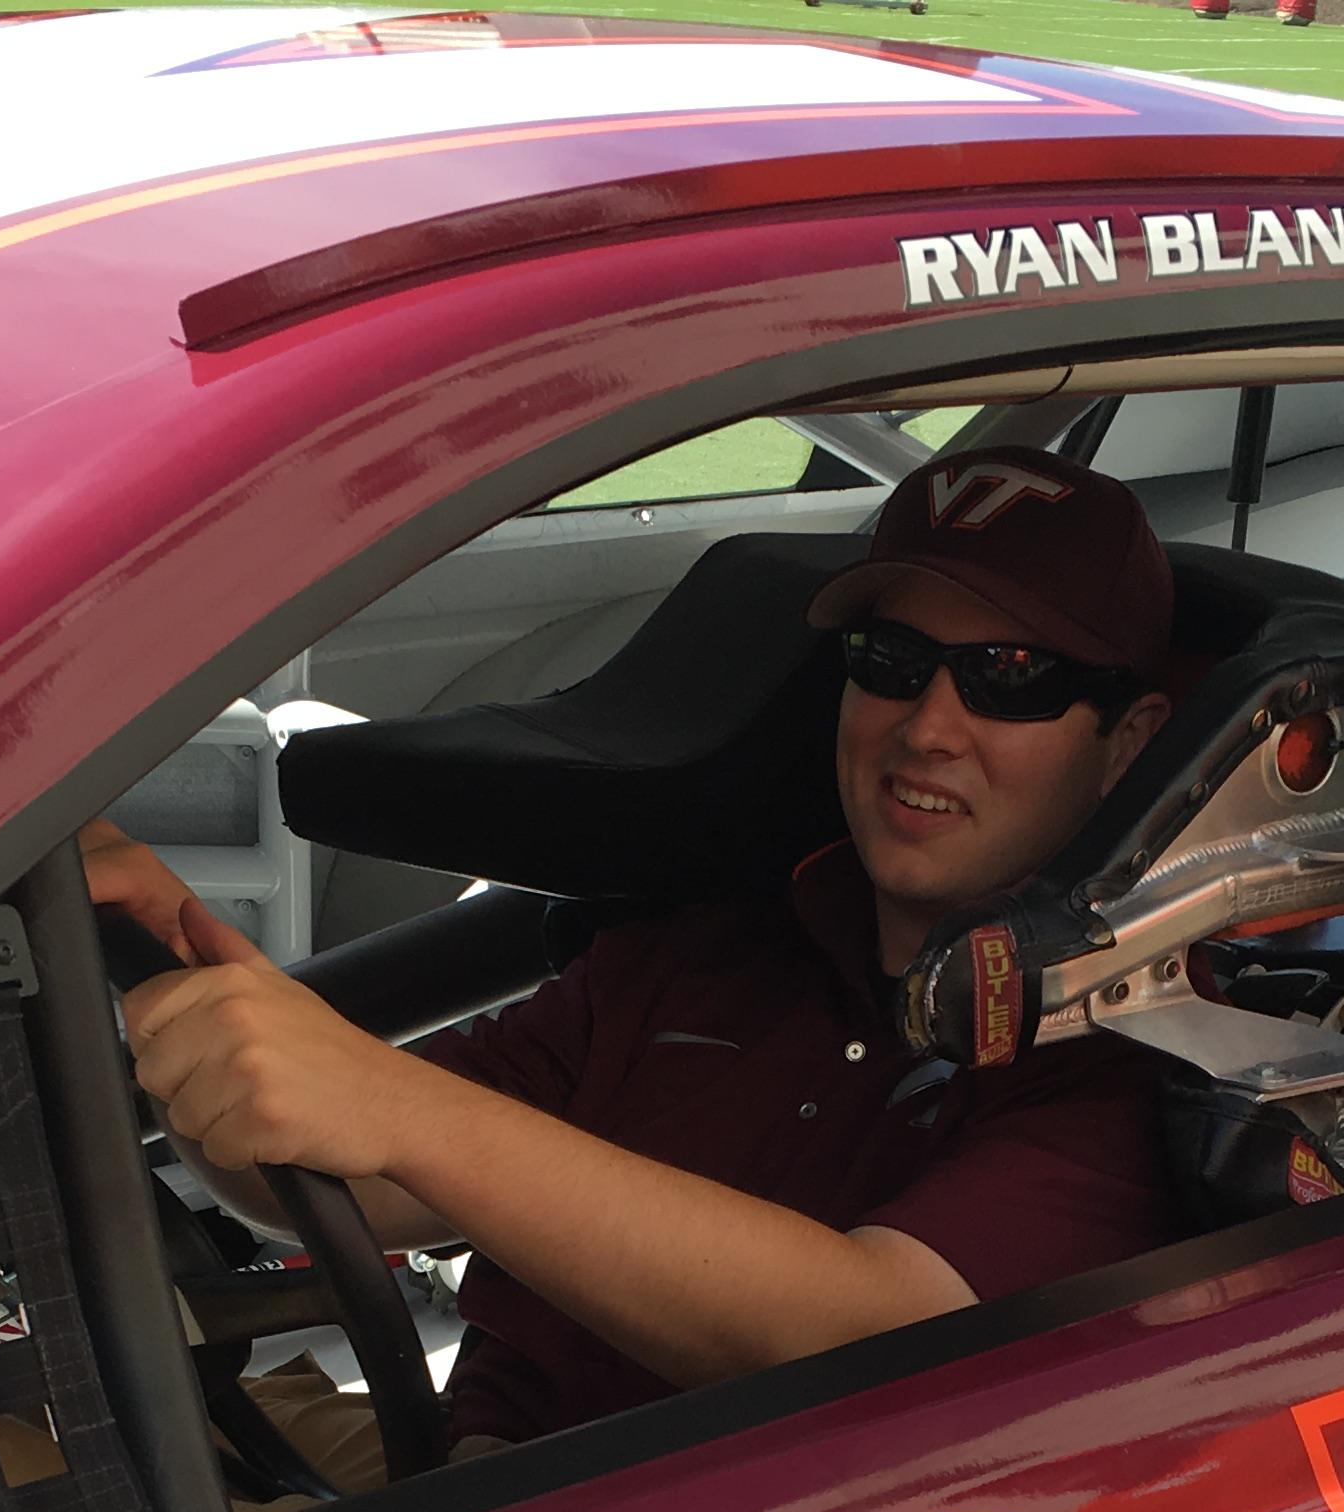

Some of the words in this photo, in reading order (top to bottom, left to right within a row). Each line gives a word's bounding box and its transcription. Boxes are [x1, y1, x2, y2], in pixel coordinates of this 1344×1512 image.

[901, 217, 1119, 306] RYAN
[928, 463, 1076, 531] VT
[982, 939, 1012, 1044] BUTLER
